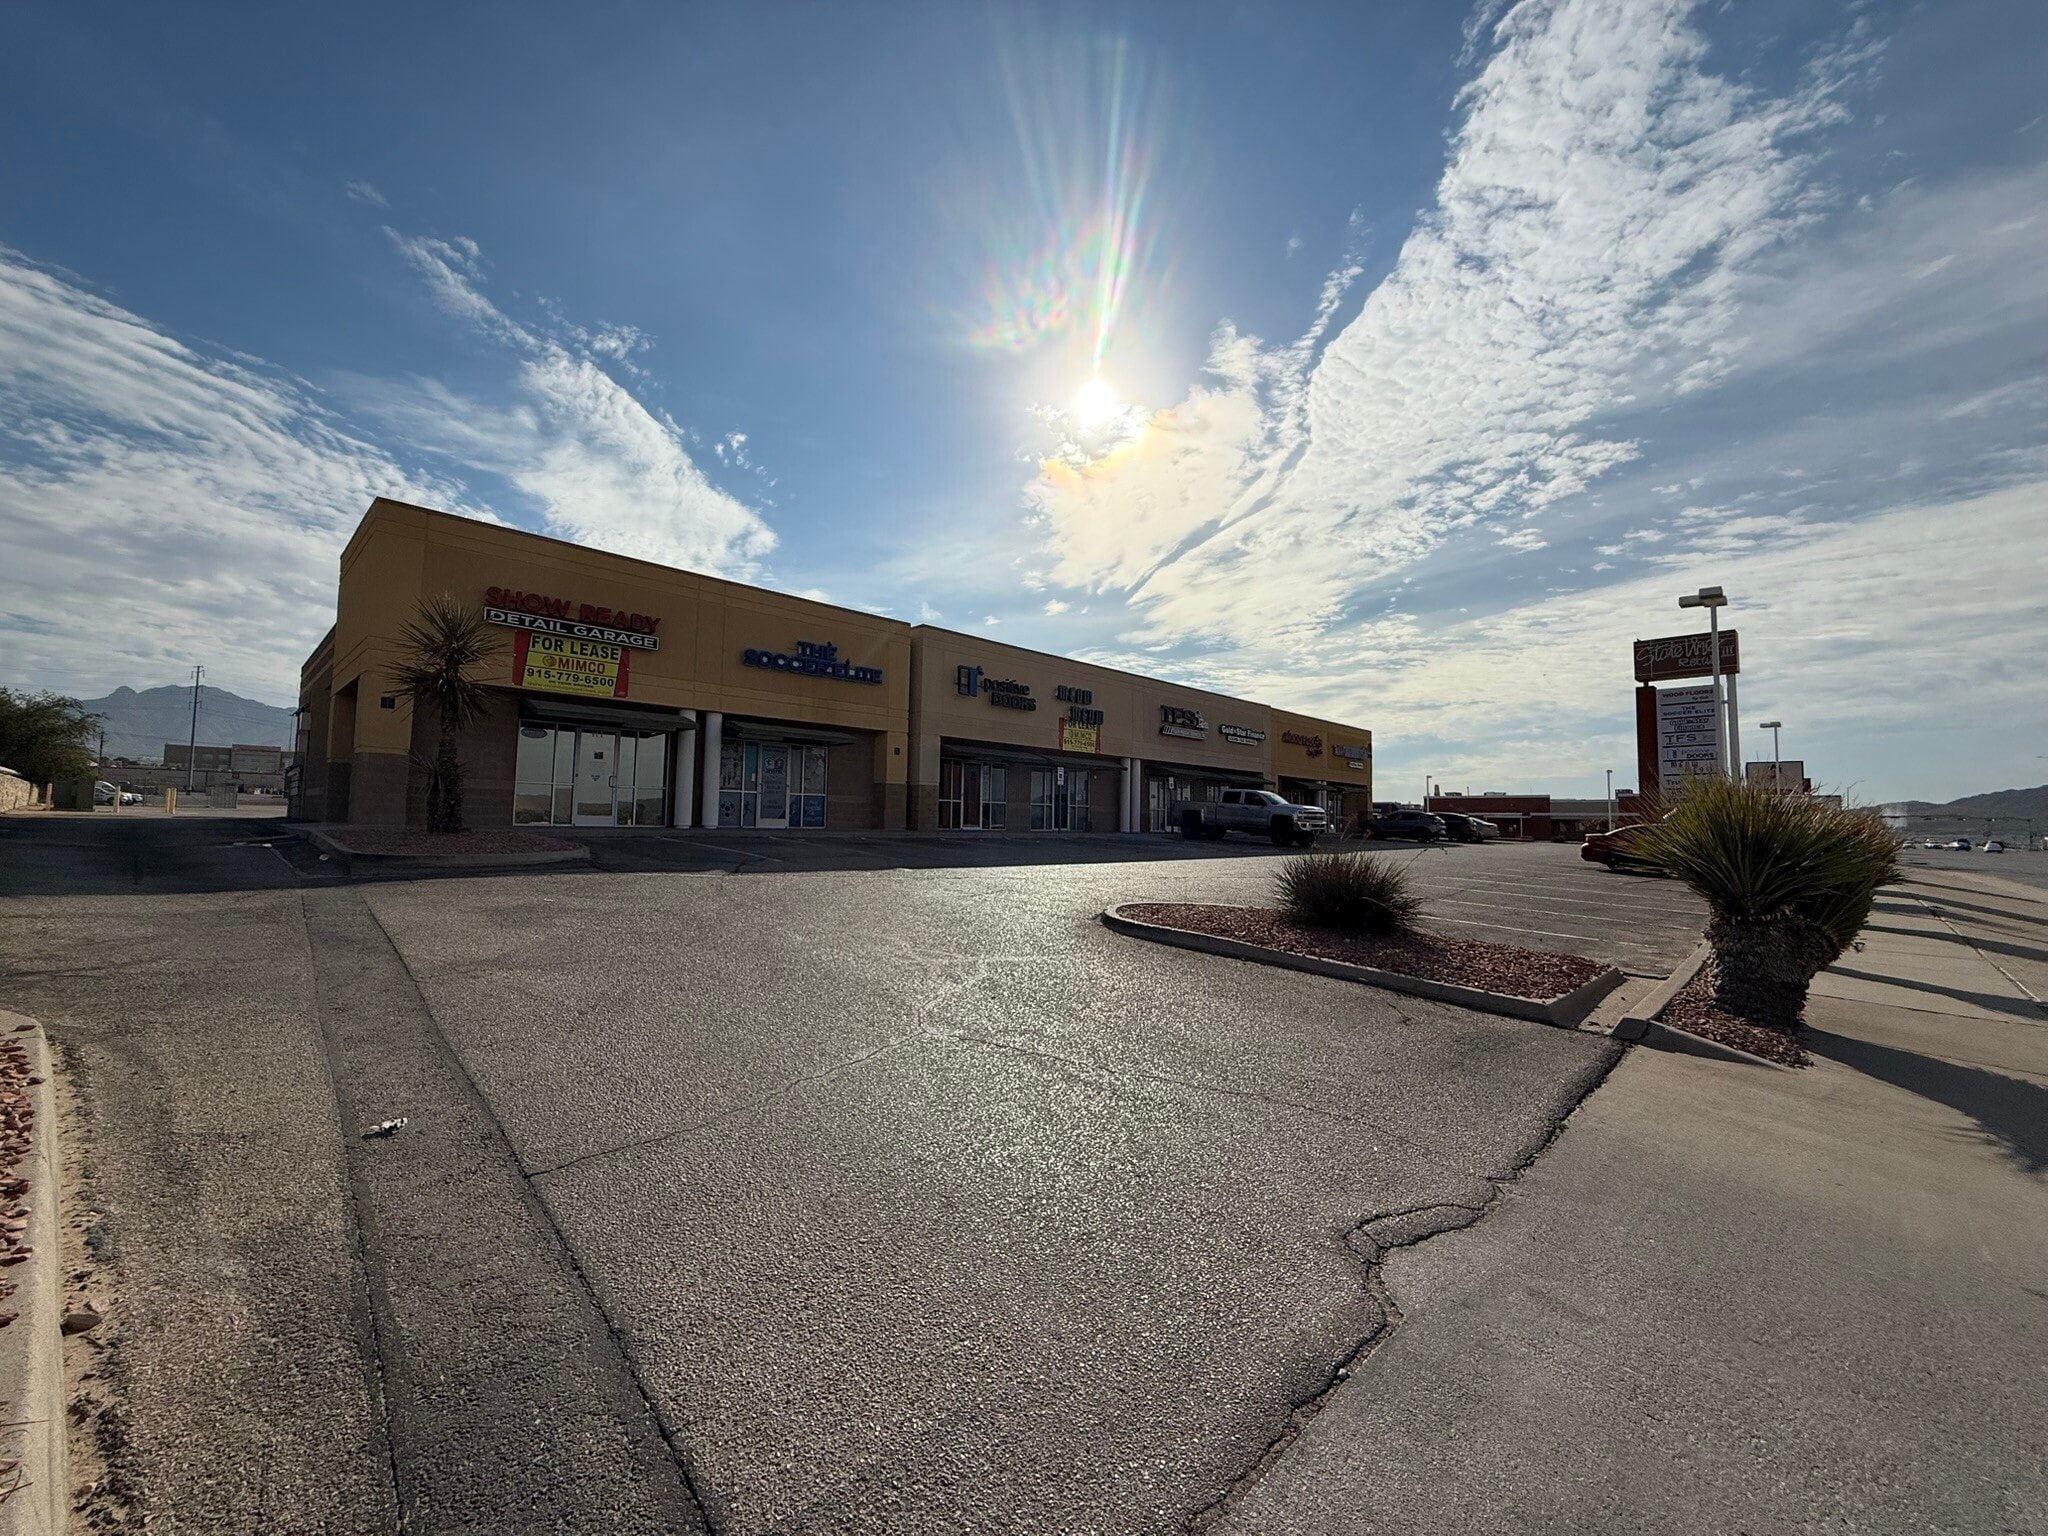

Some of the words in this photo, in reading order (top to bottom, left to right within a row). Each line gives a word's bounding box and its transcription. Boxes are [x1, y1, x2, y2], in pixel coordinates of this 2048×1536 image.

[485, 586, 571, 618] SHOW
[579, 603, 661, 635] READY
[490, 610, 567, 633] DETAIL
[573, 625, 655, 648] GARAGE
[531, 634, 564, 653] FOR
[570, 640, 620, 661] LEASE
[797, 640, 838, 662] THE
[557, 657, 606, 675] MIMCO
[526, 667, 615, 688] 915-779-6500
[983, 678, 1030, 696] positive
[991, 692, 1037, 711] DOORS
[1065, 719, 1077, 729] FOR
[1664, 733, 1697, 743] TFS
